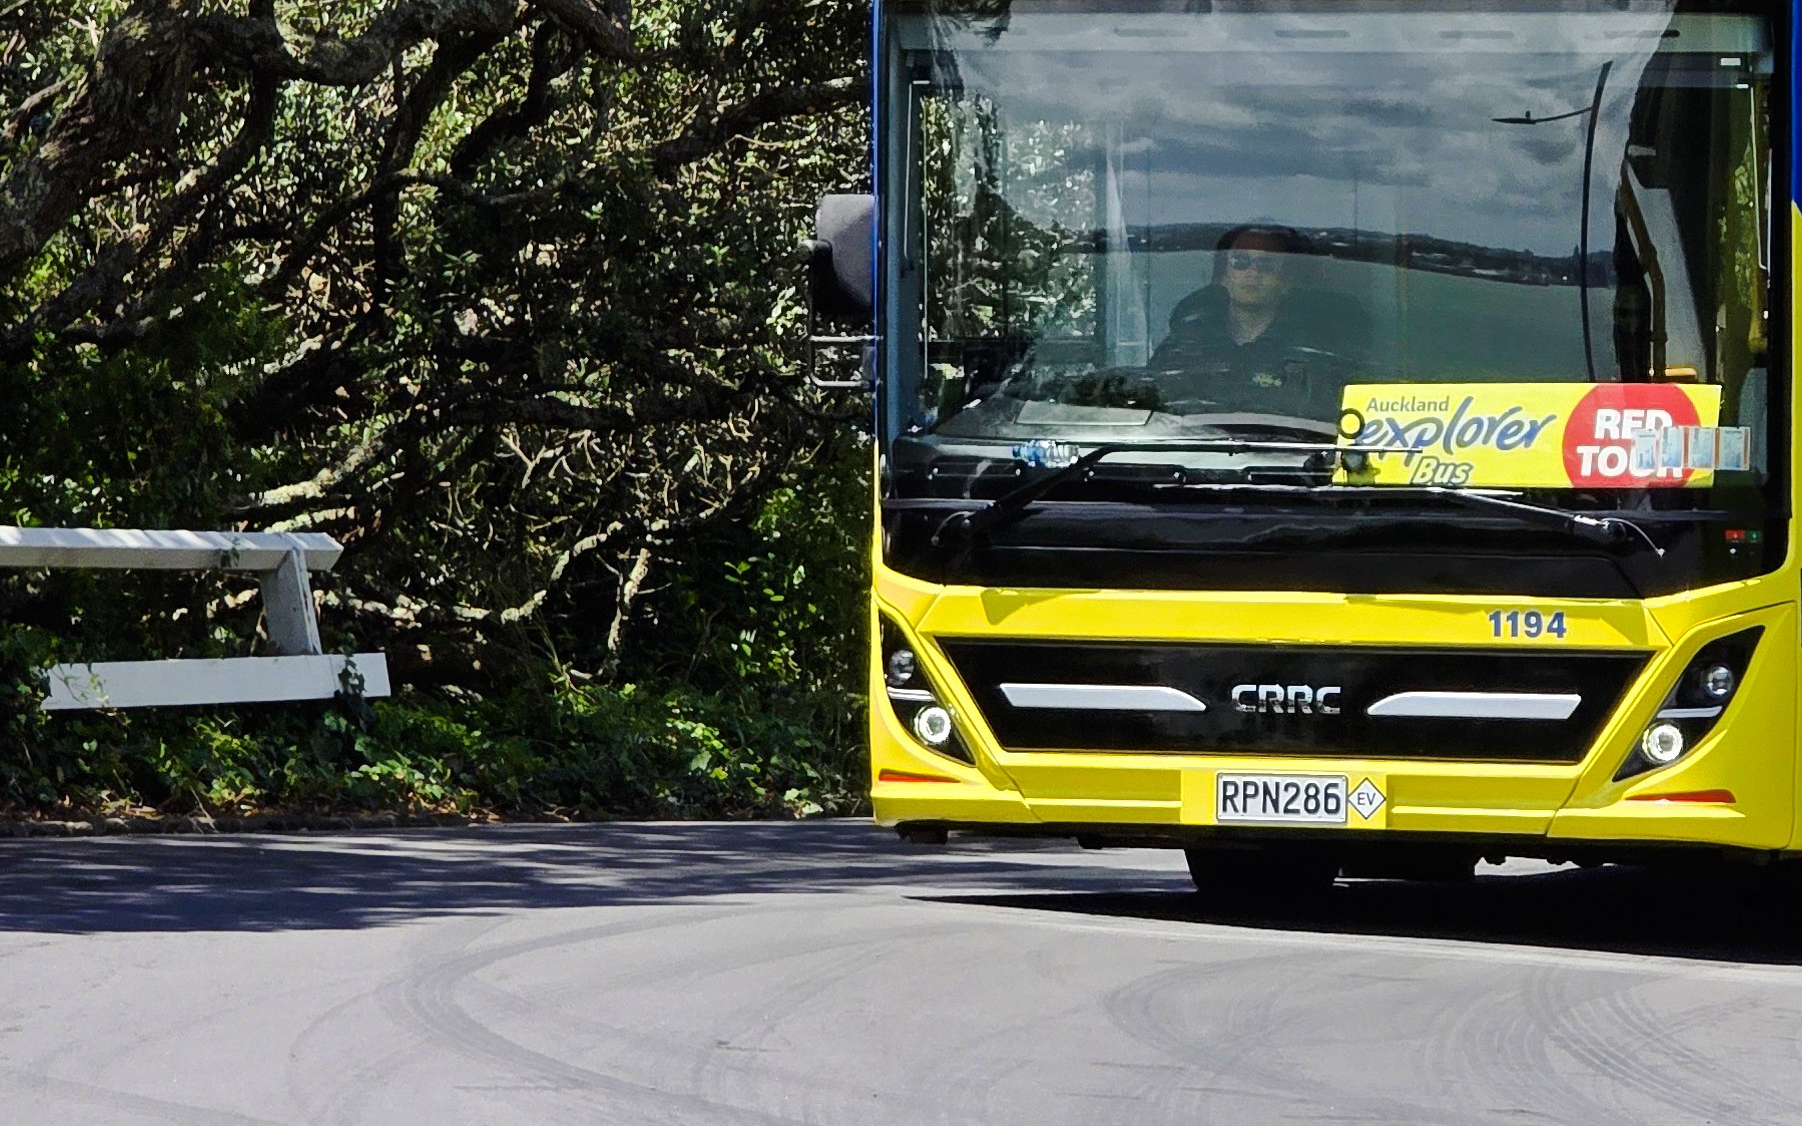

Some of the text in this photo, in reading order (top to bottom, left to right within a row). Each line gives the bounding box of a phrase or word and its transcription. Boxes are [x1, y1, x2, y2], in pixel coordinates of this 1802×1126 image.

[1366, 396, 1450, 413] Auckland
[1355, 395, 1557, 467] explorer
[1594, 408, 1674, 441] RED
[1410, 455, 1473, 486] Bus
[1489, 610, 1566, 638] 1194
[1231, 684, 1342, 714] CRRC
[1222, 780, 1341, 814] RPN286
[1357, 791, 1377, 806] EV
